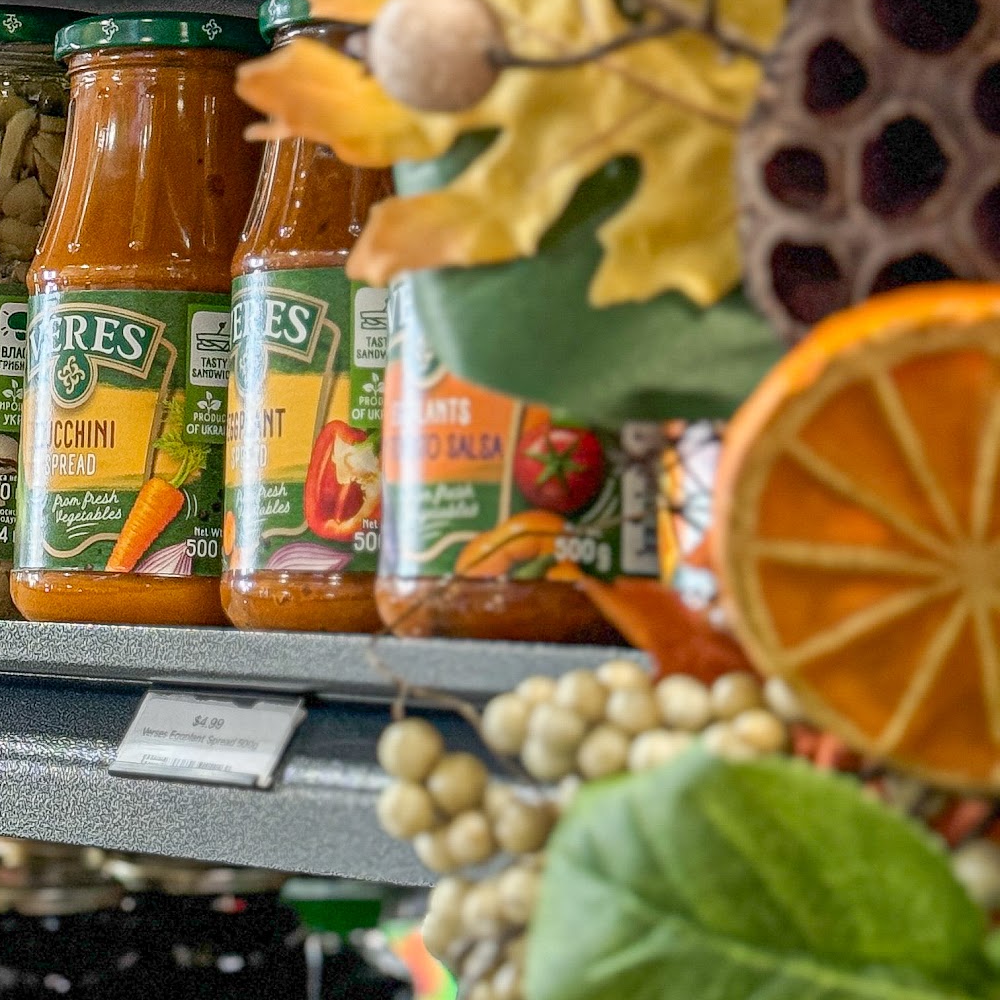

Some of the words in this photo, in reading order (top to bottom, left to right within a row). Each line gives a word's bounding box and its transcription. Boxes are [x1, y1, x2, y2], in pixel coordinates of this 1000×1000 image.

[232, 297, 310, 344] EES
[29, 313, 146, 362] VERES
[366, 337, 388, 348] TAST
[201, 356, 228, 369] TASTY
[192, 367, 230, 380] SANDWIC
[193, 412, 226, 422] PRODUC
[352, 408, 365, 420] OF
[49, 420, 116, 449] CCHINI
[187, 423, 199, 434] OF
[44, 453, 96, 477] SPREAD
[52, 493, 81, 512] from
[81, 490, 120, 510] fresh
[56, 506, 122, 526] Vegetables
[363, 518, 378, 529] Net
[194, 527, 208, 536] Net
[186, 538, 218, 557] 500
[192, 714, 225, 730] $4.99
